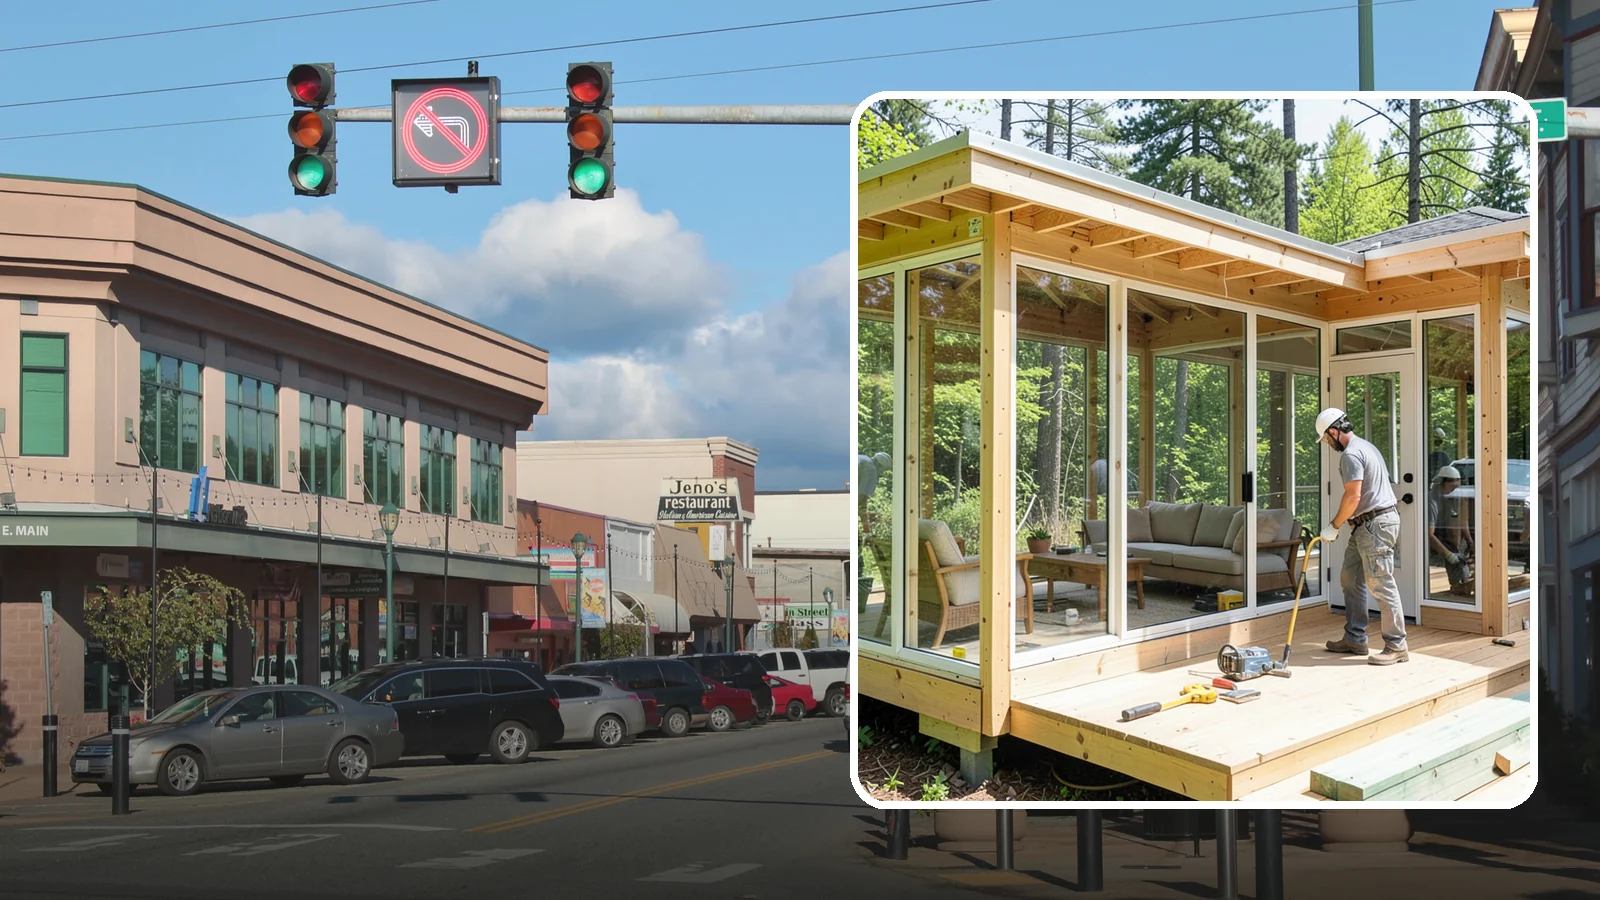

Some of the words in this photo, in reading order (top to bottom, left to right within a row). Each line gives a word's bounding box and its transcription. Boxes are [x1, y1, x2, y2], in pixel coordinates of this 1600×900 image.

[669, 479, 728, 495] Jeno's
[664, 496, 731, 509] restaurant
[658, 509, 682, 520] Italian
[686, 509, 715, 519] American
[715, 509, 738, 519] Cuisine
[2, 525, 13, 536] E.
[15, 525, 49, 536] MAIN
[797, 606, 828, 617] Street
[791, 619, 824, 627] lass
